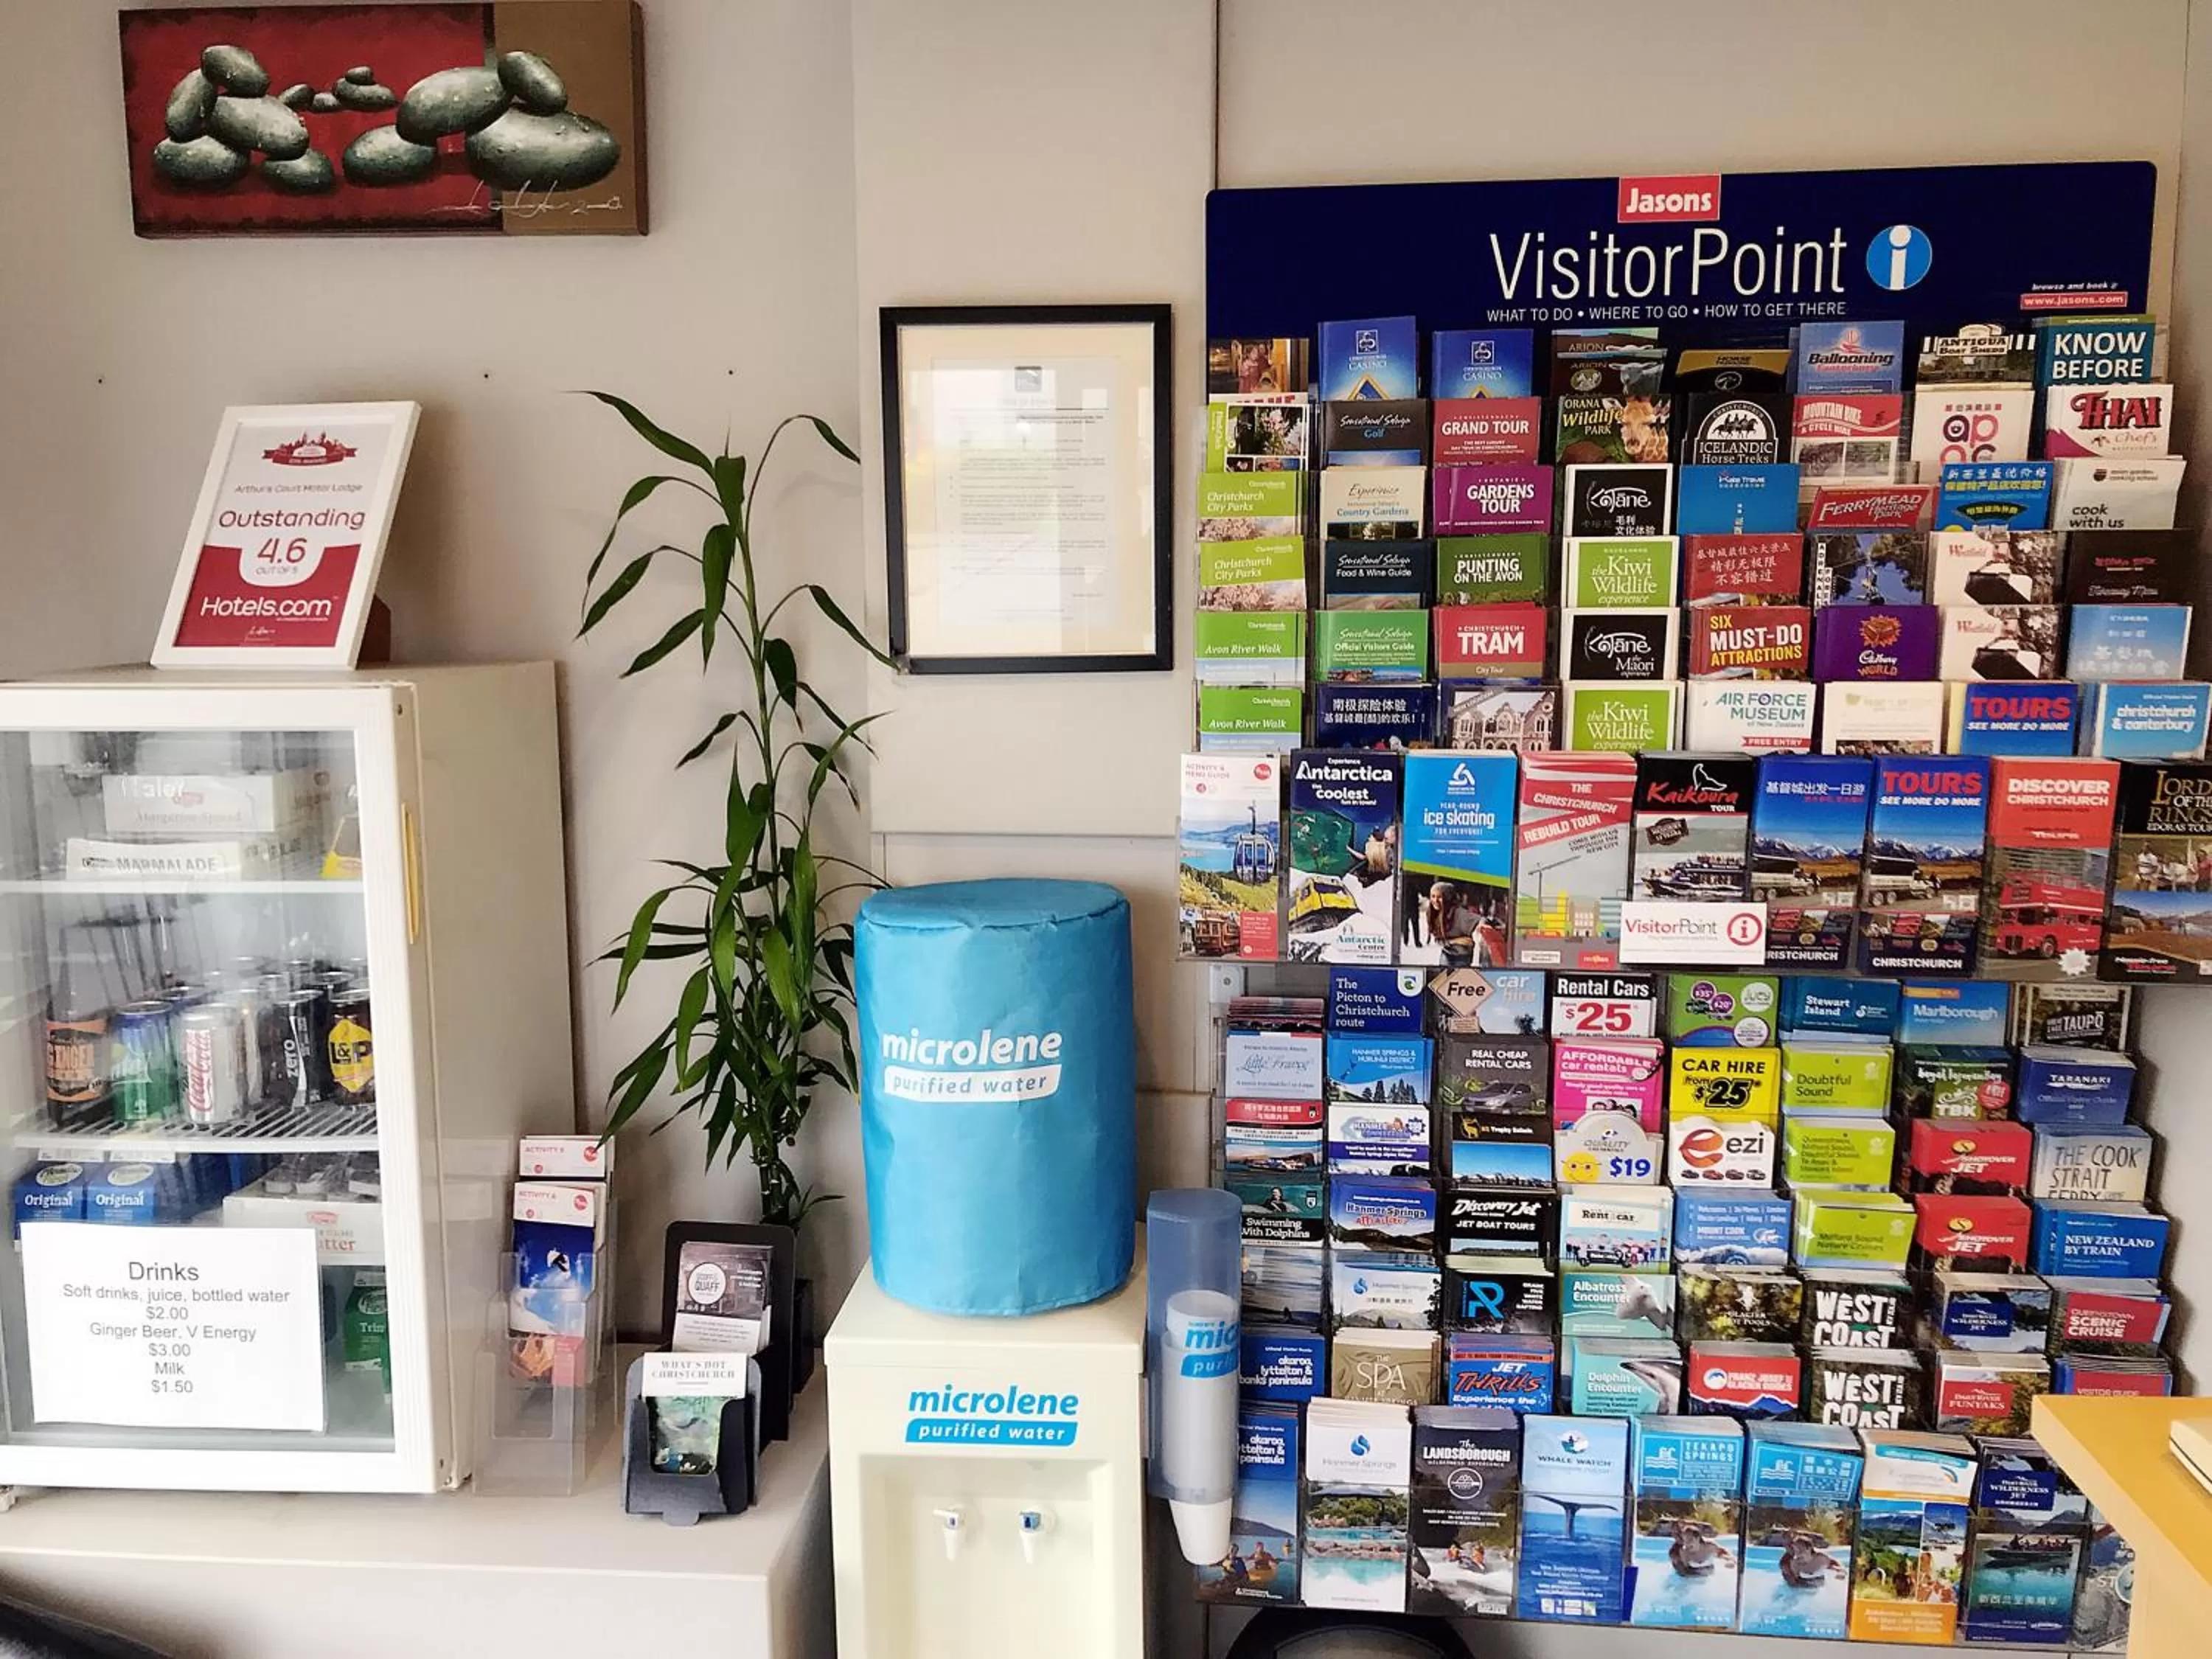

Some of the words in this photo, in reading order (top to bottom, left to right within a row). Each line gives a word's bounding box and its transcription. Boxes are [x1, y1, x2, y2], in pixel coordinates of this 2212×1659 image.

[1626, 187, 1711, 214] Jasons
[1489, 226, 1847, 300] VisitorPoint
[2024, 294, 2124, 306] www.jasons.com
[1487, 308, 1526, 322] WHAT
[1530, 308, 1548, 321] TO
[1552, 307, 1573, 321] DO
[1590, 306, 1641, 320] WHERE
[1645, 305, 1663, 319] TO
[1667, 305, 1688, 319] GO
[1705, 303, 1738, 318] HOW
[1742, 303, 1762, 316] TO
[1765, 302, 1795, 316] GET
[1798, 301, 1846, 316] THERE
[1939, 337, 2006, 347] ANTIGUA
[2055, 331, 2146, 355] KNOW
[1808, 352, 1896, 366] Ballooning
[2053, 358, 2144, 379] BEFORE
[1564, 398, 1601, 410] ORANA
[1562, 408, 1622, 428] Wildlife
[1363, 427, 1385, 439] Golf
[1441, 421, 1489, 436] GRAND
[1492, 420, 1530, 434] TOUR
[1585, 425, 1612, 436] PARK
[1698, 442, 1774, 454] ICELANDIC
[1702, 453, 1733, 464] Horse
[1736, 453, 1770, 464] Treks
[274, 483, 302, 493] Court
[303, 483, 331, 493] Motor
[332, 483, 364, 494] Lodge
[1467, 483, 1535, 500] GARDENS
[1207, 491, 1265, 503] Christchurch
[1207, 502, 1227, 513] City
[1228, 502, 1254, 512] Parks
[1480, 498, 1521, 514] TOUR
[2073, 503, 2109, 515] cook
[218, 508, 366, 531] Outstanding
[2069, 515, 2104, 528] with
[2107, 518, 2125, 528] us
[257, 537, 307, 564] 4.6
[1456, 558, 1520, 573] PUNTING
[1592, 565, 1608, 576] the
[1607, 554, 1652, 576] Kiwi
[1453, 572, 1471, 584] ON
[1472, 572, 1492, 583] THE
[1495, 571, 1523, 582] AVON
[1590, 575, 1658, 594] Wildlife
[200, 595, 333, 617] Hotels.com
[1710, 614, 1733, 630] SIX
[1457, 632, 1524, 655] TRAM
[1710, 624, 1803, 652] MUST-DO
[1205, 644, 1226, 655] Avon
[1228, 644, 1256, 655] River
[1257, 644, 1281, 654] Walk
[1711, 644, 1802, 667] ATTRACTIONS
[1716, 692, 1745, 706] AIR
[1747, 692, 1807, 706] FORCE
[1730, 707, 1806, 720] MUSEUM
[1970, 698, 2070, 720] TOURS
[2116, 704, 2197, 718] christchurch
[1748, 738, 1772, 747] FREE
[1773, 739, 1803, 747] ENTRY
[1295, 760, 1393, 783] Antarctica
[1571, 783, 1593, 794] THE
[1882, 771, 1983, 794] TOURS
[2008, 778, 2110, 795] DISCOVER
[1646, 782, 1739, 805] Kaikoura
[2006, 794, 2109, 807] CHRISTCHURCH
[1423, 808, 1444, 826] ice
[1446, 809, 1495, 830] skating
[1523, 819, 1570, 844] REBUILD
[1571, 813, 1601, 830] TOUR
[116, 857, 218, 872] MARMALADE
[1335, 977, 1358, 990] The
[1496, 975, 1529, 988] car
[1557, 978, 1609, 996] Rental
[1616, 979, 1649, 997] Cars
[1447, 981, 1486, 998] Free
[1335, 991, 1371, 1004] Picton
[1374, 993, 1387, 1004] to
[1805, 995, 1851, 1008] Stewart
[1335, 1004, 1411, 1018] Christchurch
[1804, 1004, 1842, 1017] Island
[1913, 1004, 1999, 1020] Marlborough
[1335, 1018, 1366, 1029] route
[331, 1040, 370, 1065] L&P
[882, 1028, 1063, 1066] microlene
[1470, 1049, 1495, 1059] REAL
[1496, 1049, 1529, 1060] CHEAP
[283, 1038, 296, 1077] zero
[1464, 1058, 1503, 1069] RENTAL
[1504, 1059, 1533, 1071] CARS
[1562, 1051, 1652, 1068] AFFORDABLE
[1682, 1058, 1723, 1072] CAR
[1726, 1060, 1766, 1074] HIRE
[892, 1074, 972, 1095] purified
[982, 1074, 1048, 1094] water
[1796, 1074, 1852, 1087] Doubtful
[2049, 1074, 2112, 1084] TARANAKI
[1795, 1085, 1834, 1097] Sound
[1935, 1103, 1978, 1117] TBK
[1725, 1131, 1764, 1154] ezi
[2054, 1145, 2085, 1165] THE
[2090, 1144, 2143, 1169] COOK
[1609, 1157, 1652, 1178] $19
[1950, 1162, 1989, 1174] JET
[2049, 1168, 2112, 1190] STRAIT
[24, 1192, 74, 1208] Original
[95, 1192, 145, 1208] Original
[1246, 1217, 1303, 1230] Swimming
[1455, 1220, 1475, 1228] JET
[1477, 1221, 1503, 1229] BOAT
[1504, 1222, 1536, 1231] TOURS
[2064, 1234, 2094, 1246] NEW
[2096, 1236, 2155, 1249] ZEALAND
[2064, 1245, 2080, 1256] BY
[2081, 1245, 2124, 1257] TRAIN
[128, 1261, 201, 1282] Drinks
[62, 1283, 92, 1298] Soft
[96, 1284, 143, 1302] drinks,
[146, 1287, 188, 1304] juice,
[192, 1289, 243, 1303] bottled
[246, 1290, 291, 1303] water
[1573, 1281, 1626, 1293] Albatross
[1573, 1293, 1631, 1304] Encounter
[145, 1306, 189, 1321] $2.00
[2070, 1316, 2127, 1329] SCENIC
[89, 1323, 138, 1340] Ginger
[186, 1325, 198, 1339] V
[203, 1325, 257, 1342] Energy
[2067, 1326, 2124, 1338] CRUISE
[147, 1343, 191, 1358] $3.00
[154, 1361, 185, 1376] Milk
[651, 1369, 736, 1380] CHRISTCHURCH
[1356, 1362, 1407, 1391] SPA
[1453, 1371, 1545, 1396] THRILLS
[151, 1379, 193, 1394] $1.50
[908, 1384, 1080, 1417] microlene
[1948, 1400, 2006, 1411] FUNYAKS
[918, 1423, 1001, 1441] purified
[1008, 1426, 1066, 1441] water
[1422, 1447, 1512, 1463] LANDSBOROUGH
[1538, 1455, 1574, 1466] WHALE
[1576, 1458, 1612, 1467] WATCH
